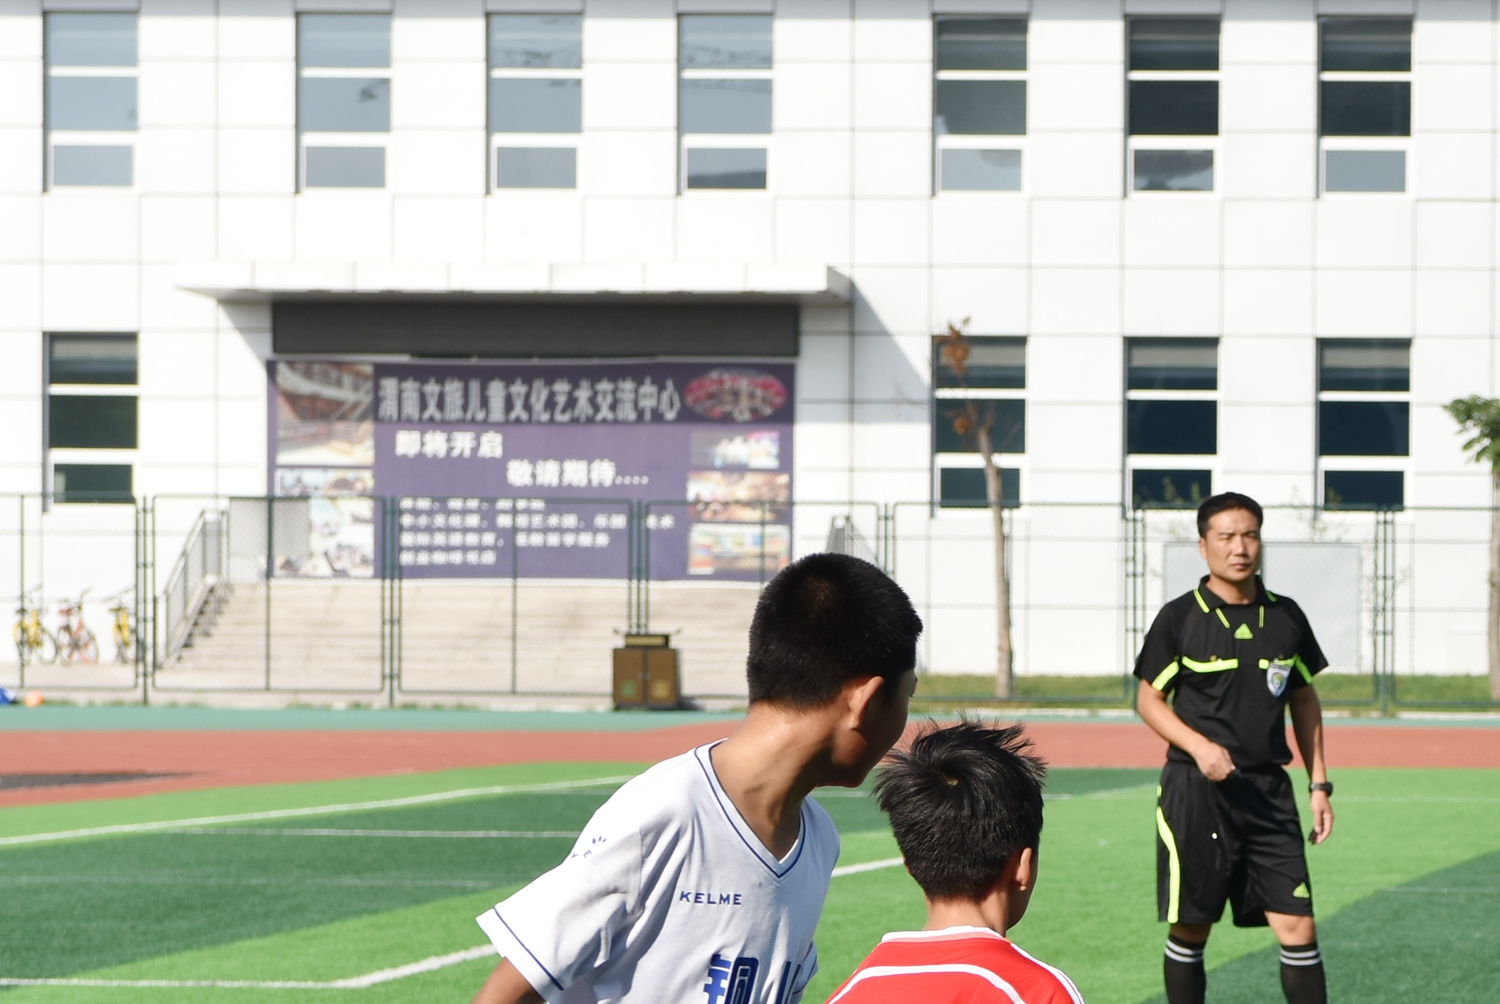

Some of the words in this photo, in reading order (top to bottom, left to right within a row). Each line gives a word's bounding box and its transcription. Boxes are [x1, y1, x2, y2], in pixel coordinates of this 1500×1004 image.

[378, 377, 681, 422] 渭南文旅儿童文化艺术交流中心
[395, 430, 503, 458] 即将开启
[679, 890, 743, 905] KELME
